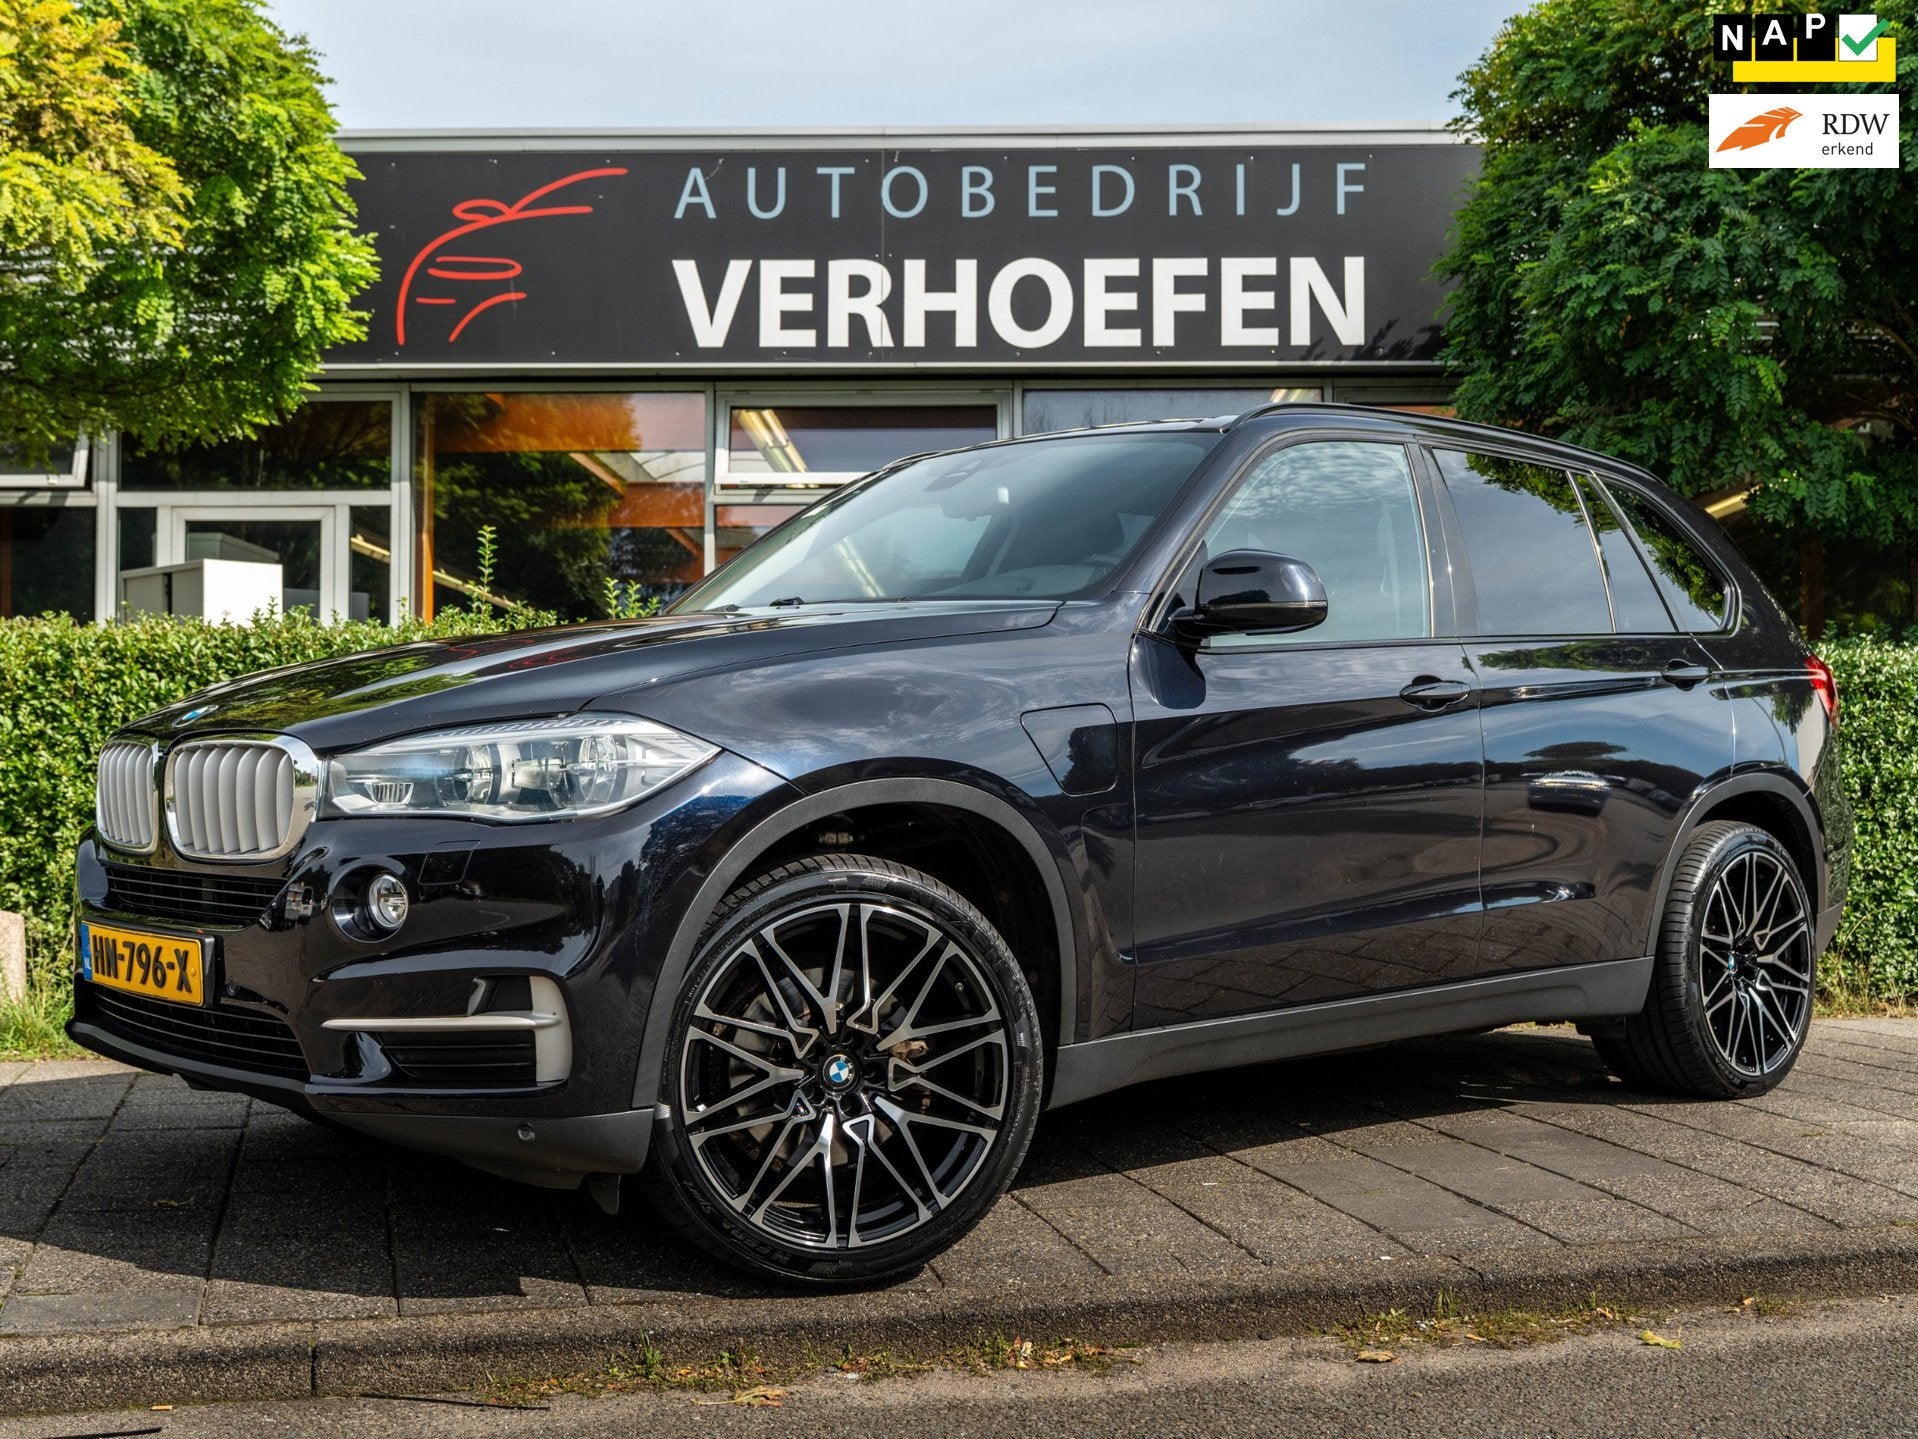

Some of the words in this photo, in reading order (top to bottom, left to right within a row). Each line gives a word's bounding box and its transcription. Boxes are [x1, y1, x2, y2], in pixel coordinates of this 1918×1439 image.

[673, 162, 1366, 219] AUTOBEDRIJF
[672, 256, 1366, 350] VERHOEFEN
[92, 934, 192, 993] HN-796-X
